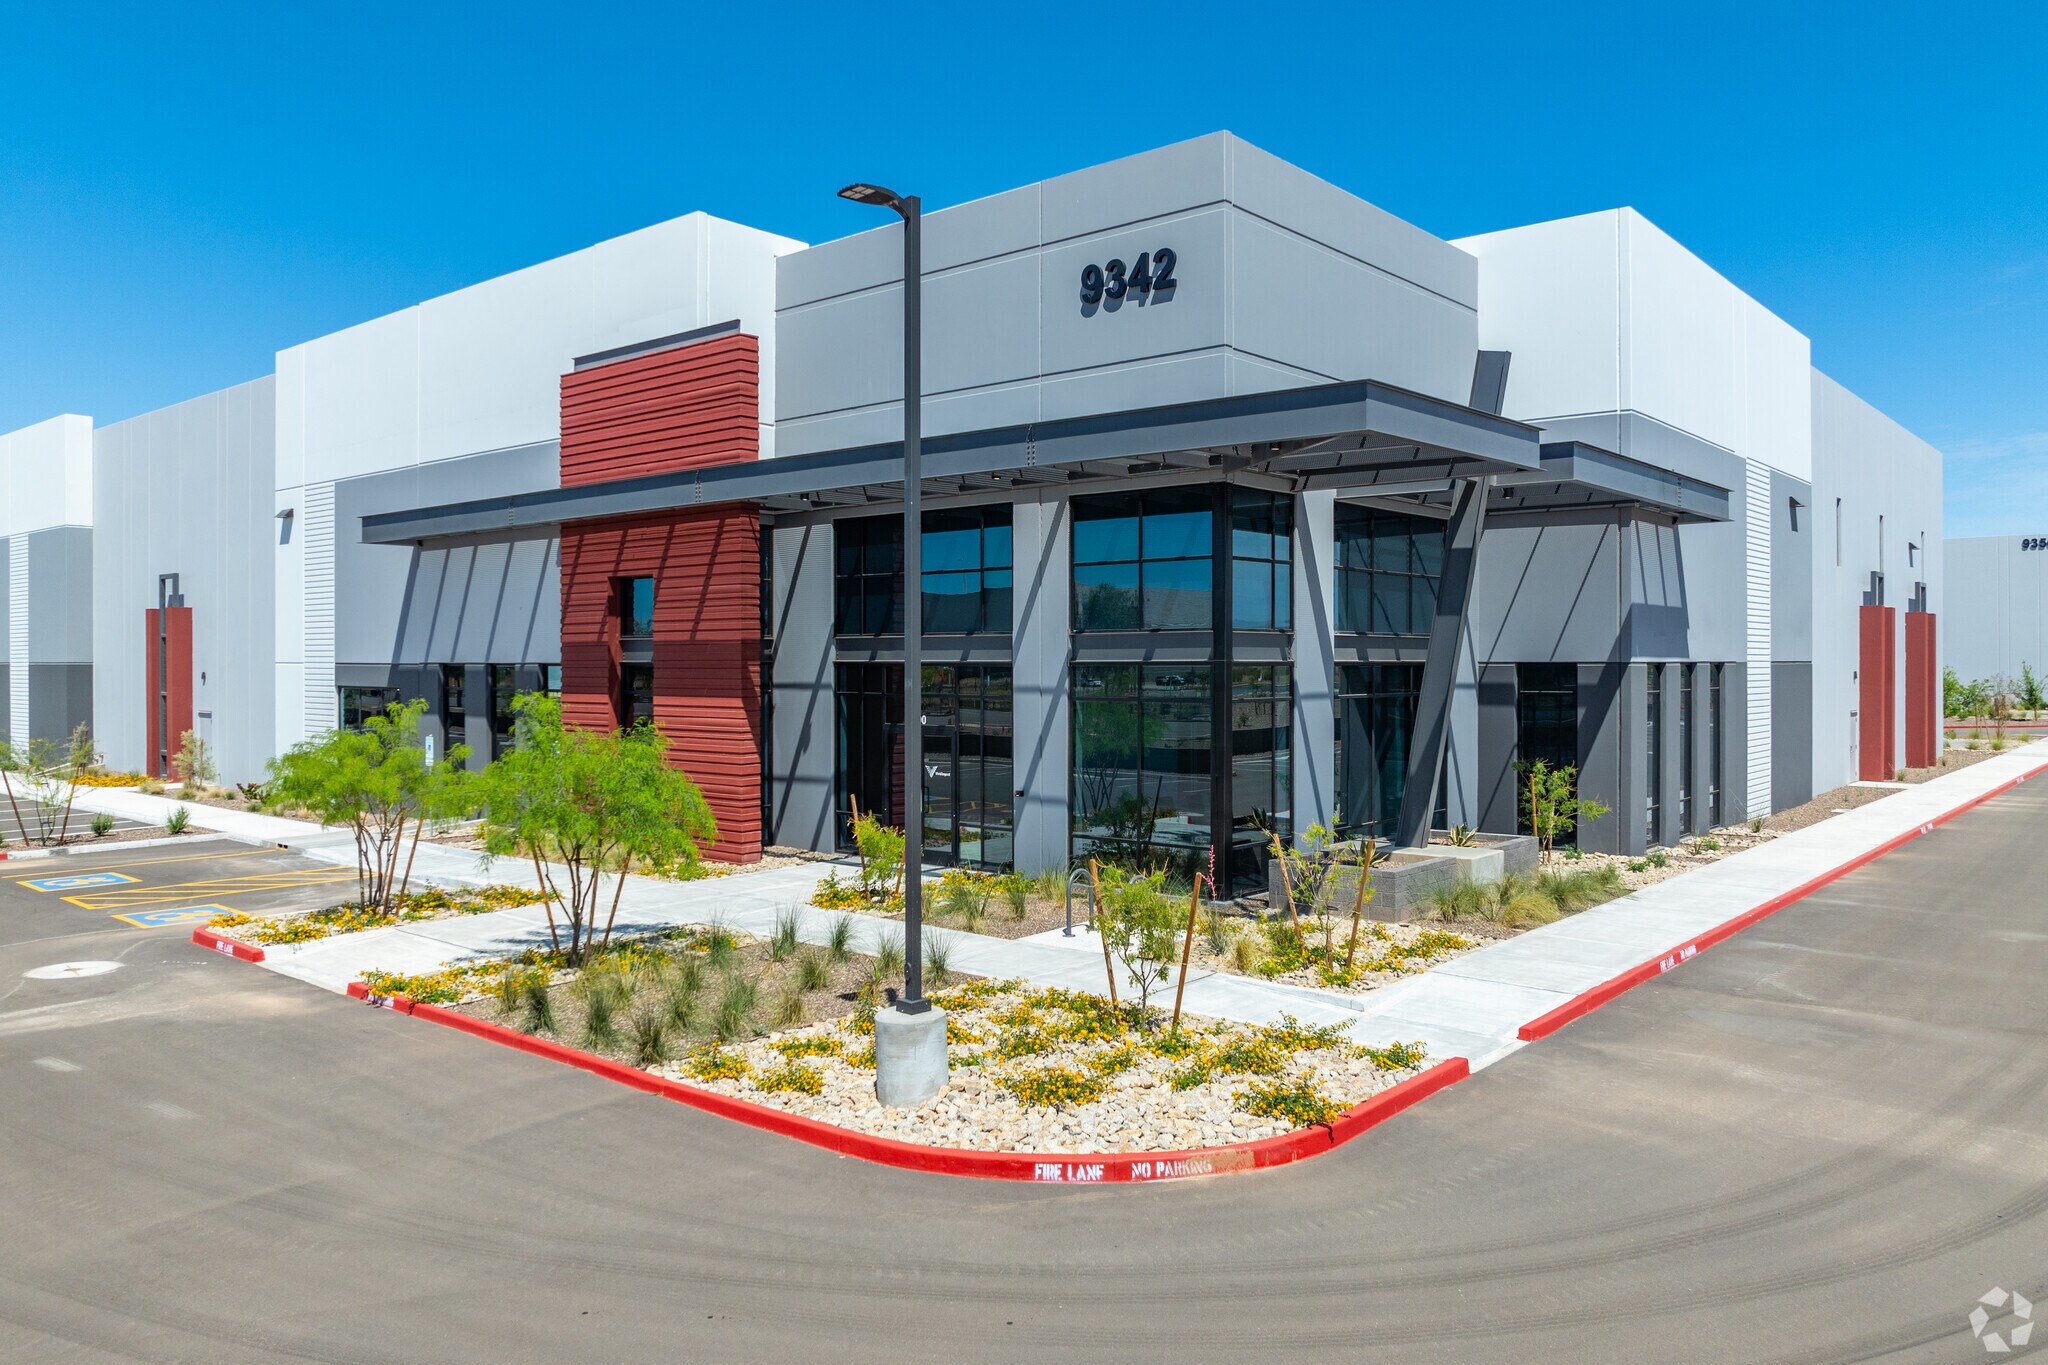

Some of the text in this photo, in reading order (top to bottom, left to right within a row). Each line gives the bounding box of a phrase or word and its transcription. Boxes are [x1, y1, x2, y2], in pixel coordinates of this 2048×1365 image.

[1081, 247, 1177, 304] 9342
[2021, 538, 2048, 549] 935
[1035, 1163, 1063, 1181] FIRE
[1132, 1160, 1212, 1179] NO PARKING
